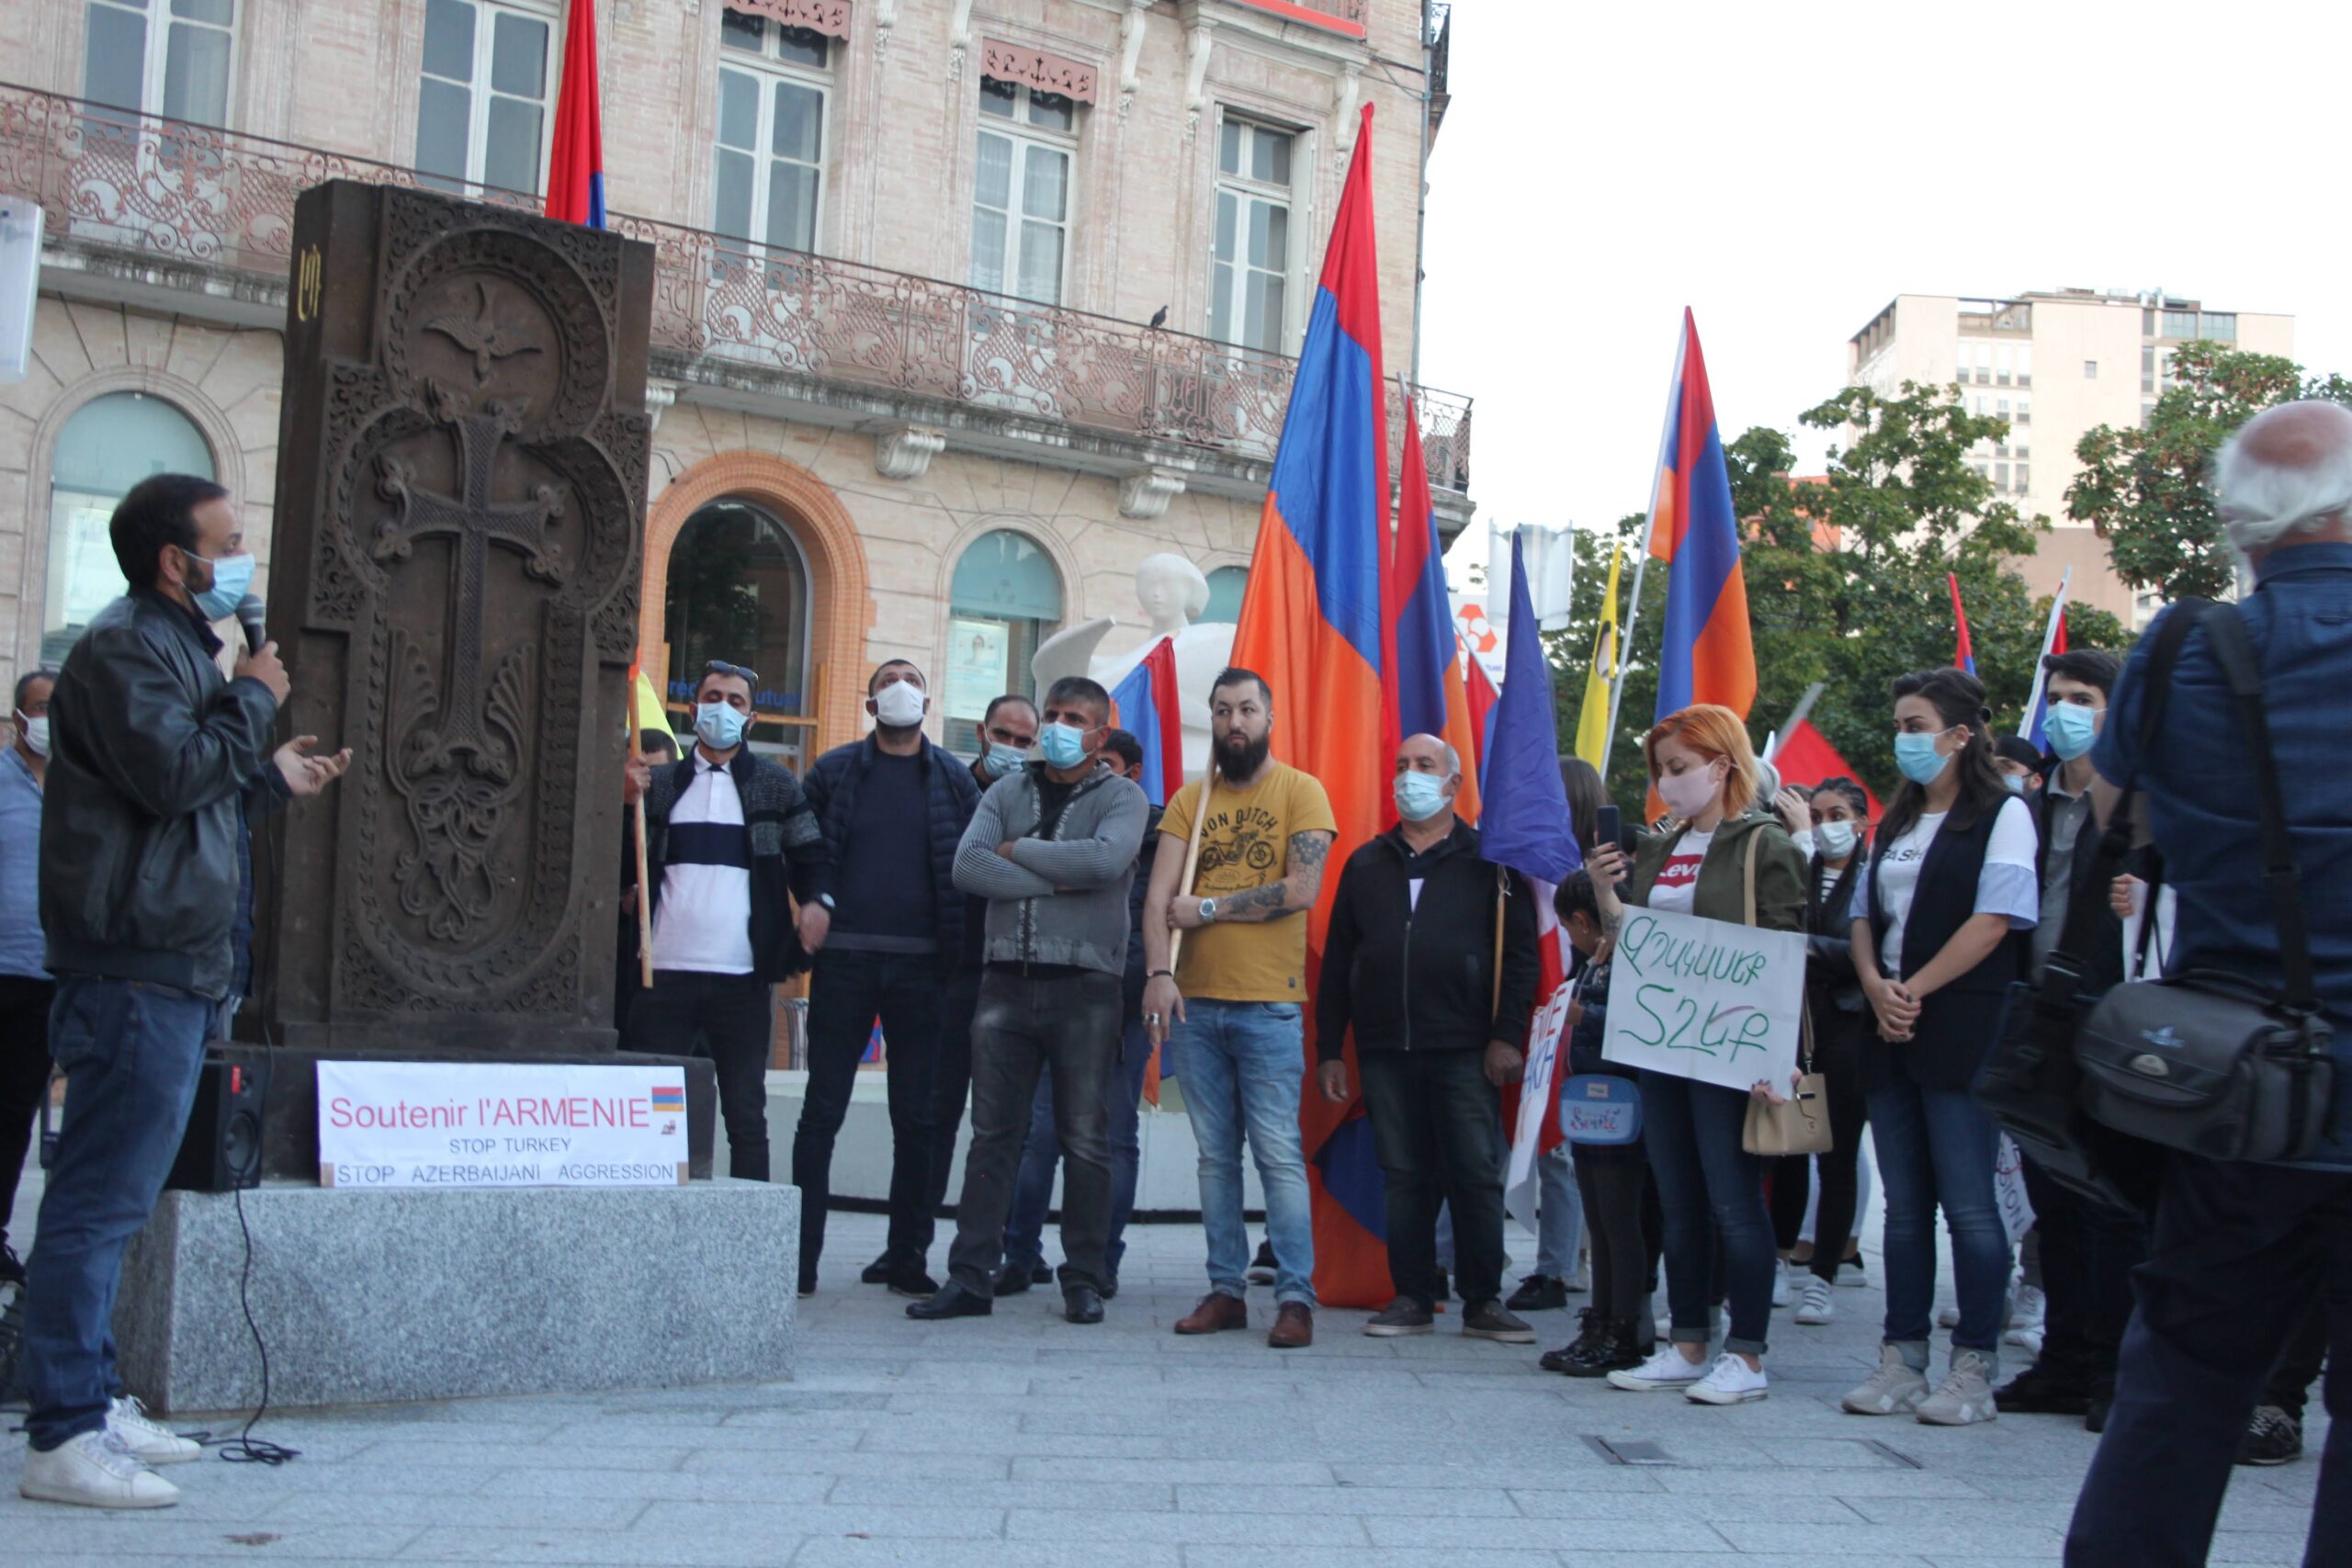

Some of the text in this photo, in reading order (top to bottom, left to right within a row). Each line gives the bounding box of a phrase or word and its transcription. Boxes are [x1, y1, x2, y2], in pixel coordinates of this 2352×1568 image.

[753, 689, 801, 706] utuel
[1200, 812, 1229, 839] VON
[330, 1097, 650, 1129] Soutenir l'ARMENIE
[449, 1136, 572, 1154] STOP TURKEY
[337, 1163, 673, 1183] STOP AZERBAIJANI AGGRESSION
